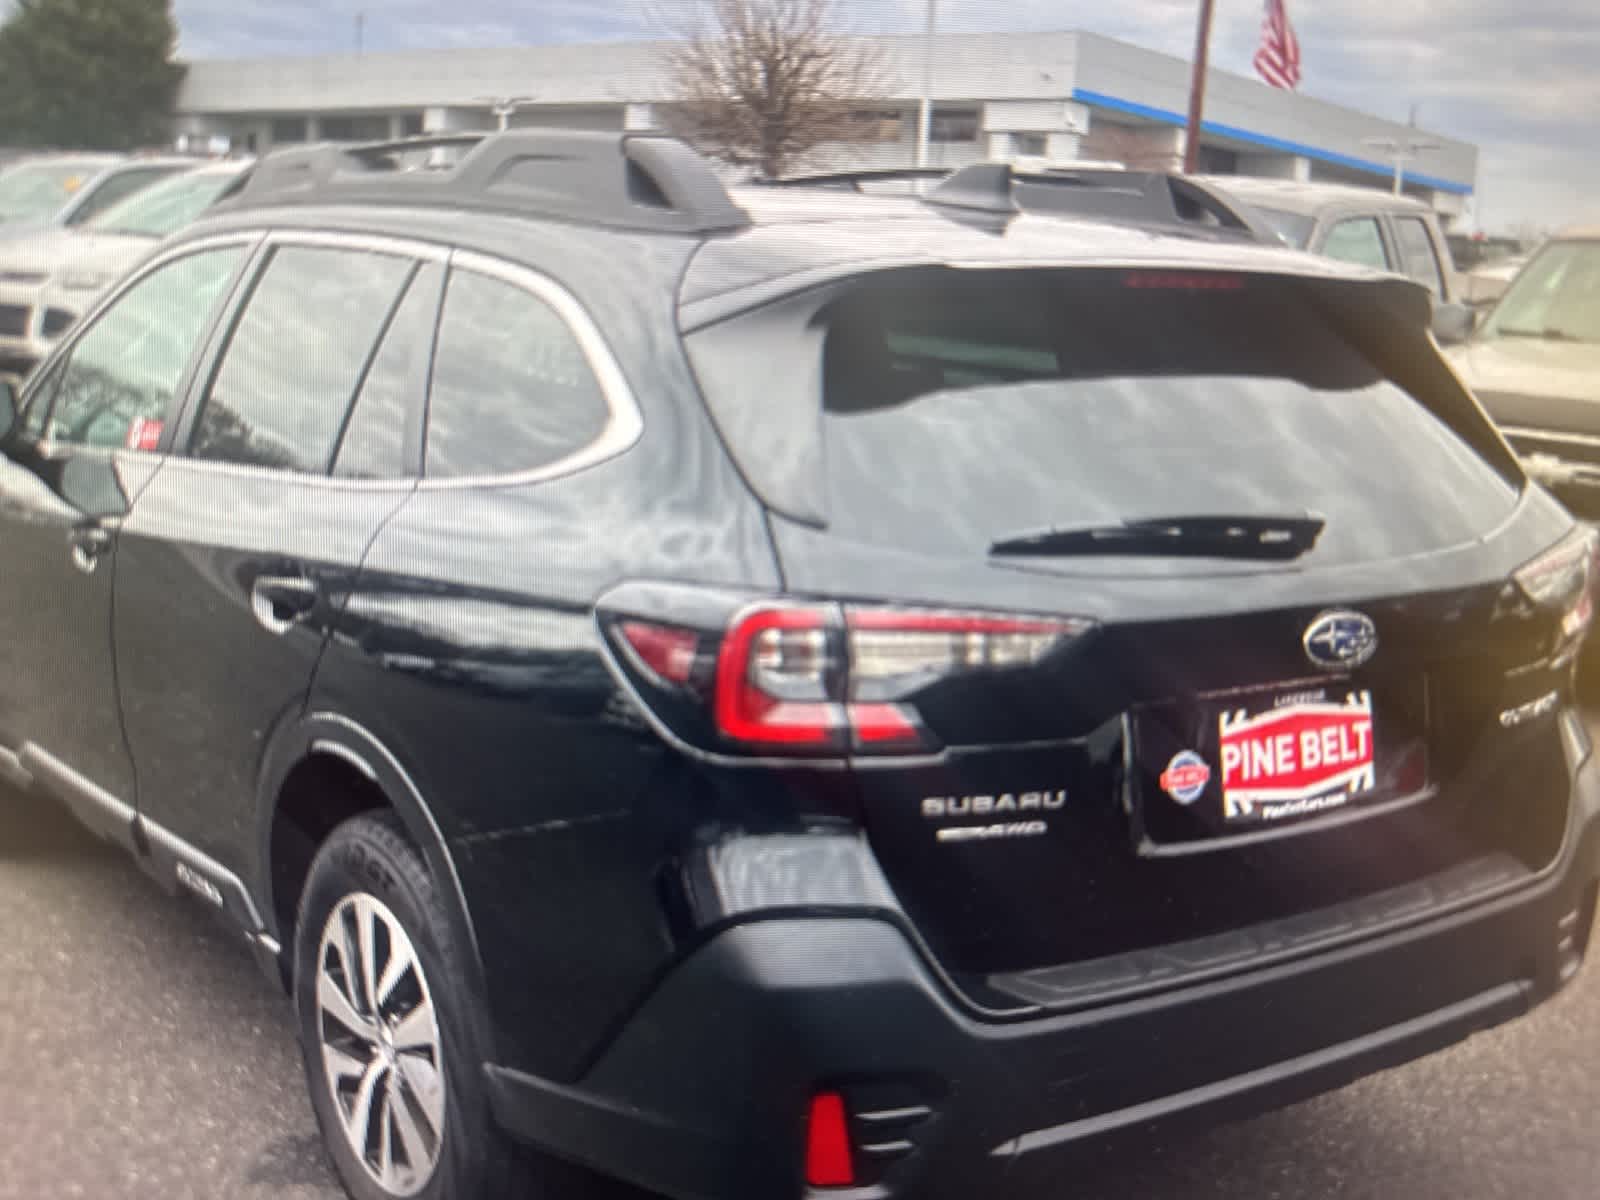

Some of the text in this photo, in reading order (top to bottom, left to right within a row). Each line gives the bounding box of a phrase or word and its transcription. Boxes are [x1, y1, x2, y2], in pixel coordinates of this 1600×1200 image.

[1221, 720, 1372, 784] PINE BELT
[920, 789, 1067, 817] SUBARU
